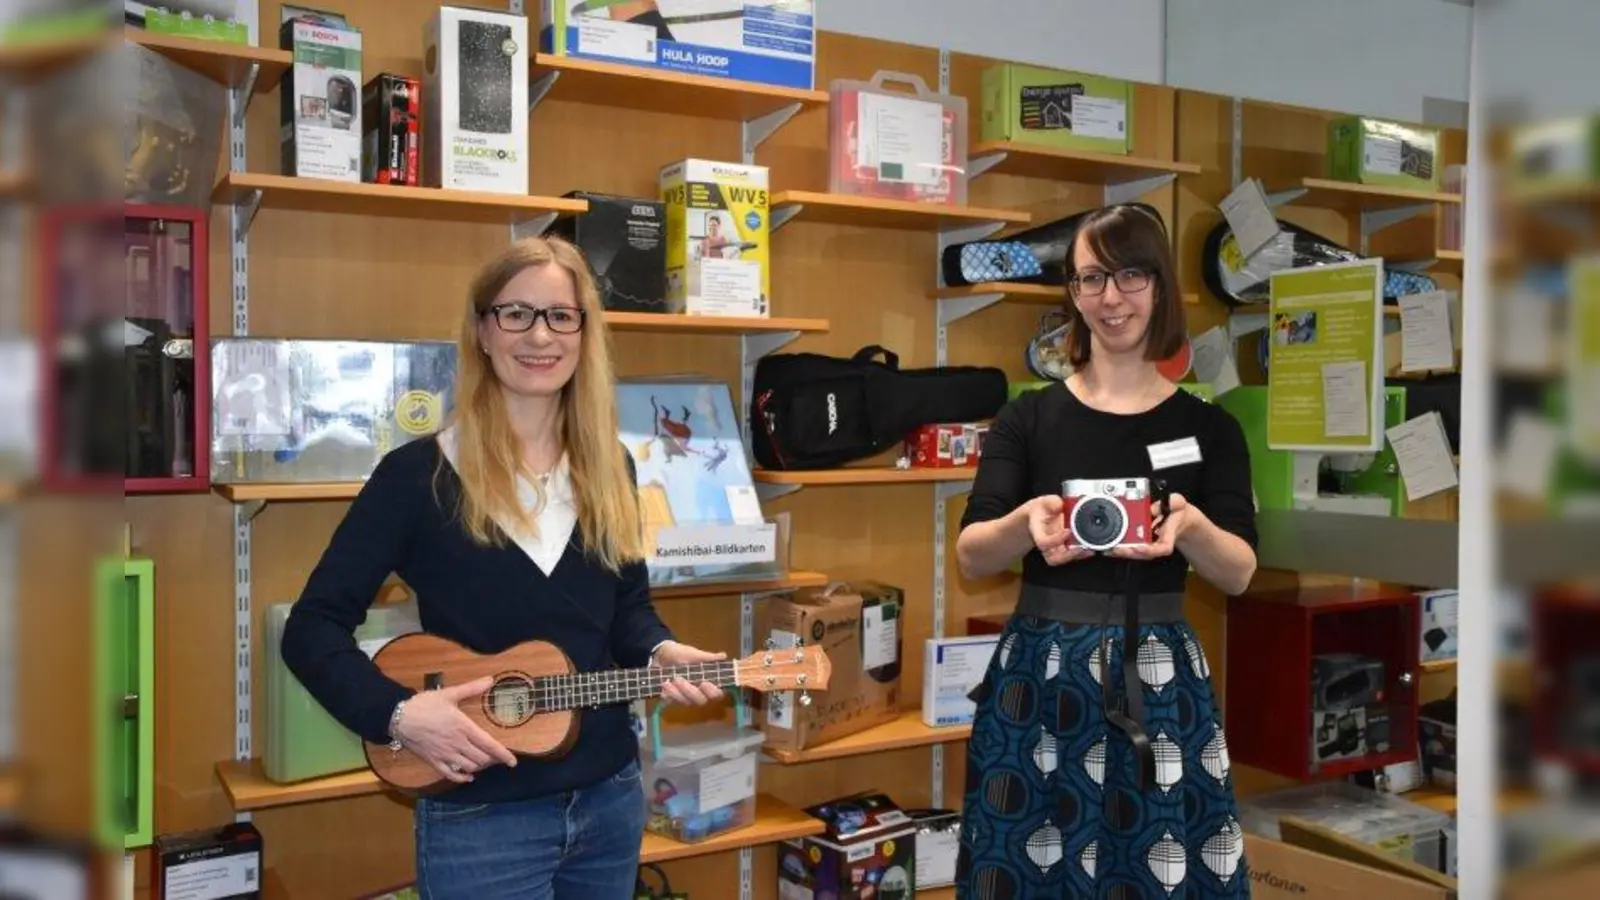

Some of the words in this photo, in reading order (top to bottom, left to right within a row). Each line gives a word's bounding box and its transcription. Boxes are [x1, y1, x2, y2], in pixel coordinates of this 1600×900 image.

[311, 31, 339, 41] BOSCH
[662, 48, 694, 64] HULA
[696, 53, 729, 67] HOOP
[728, 186, 757, 204] WV
[758, 190, 768, 205] 5
[827, 393, 837, 435] CASCHA
[656, 543, 766, 558] Kamishibai-Bildkarten
